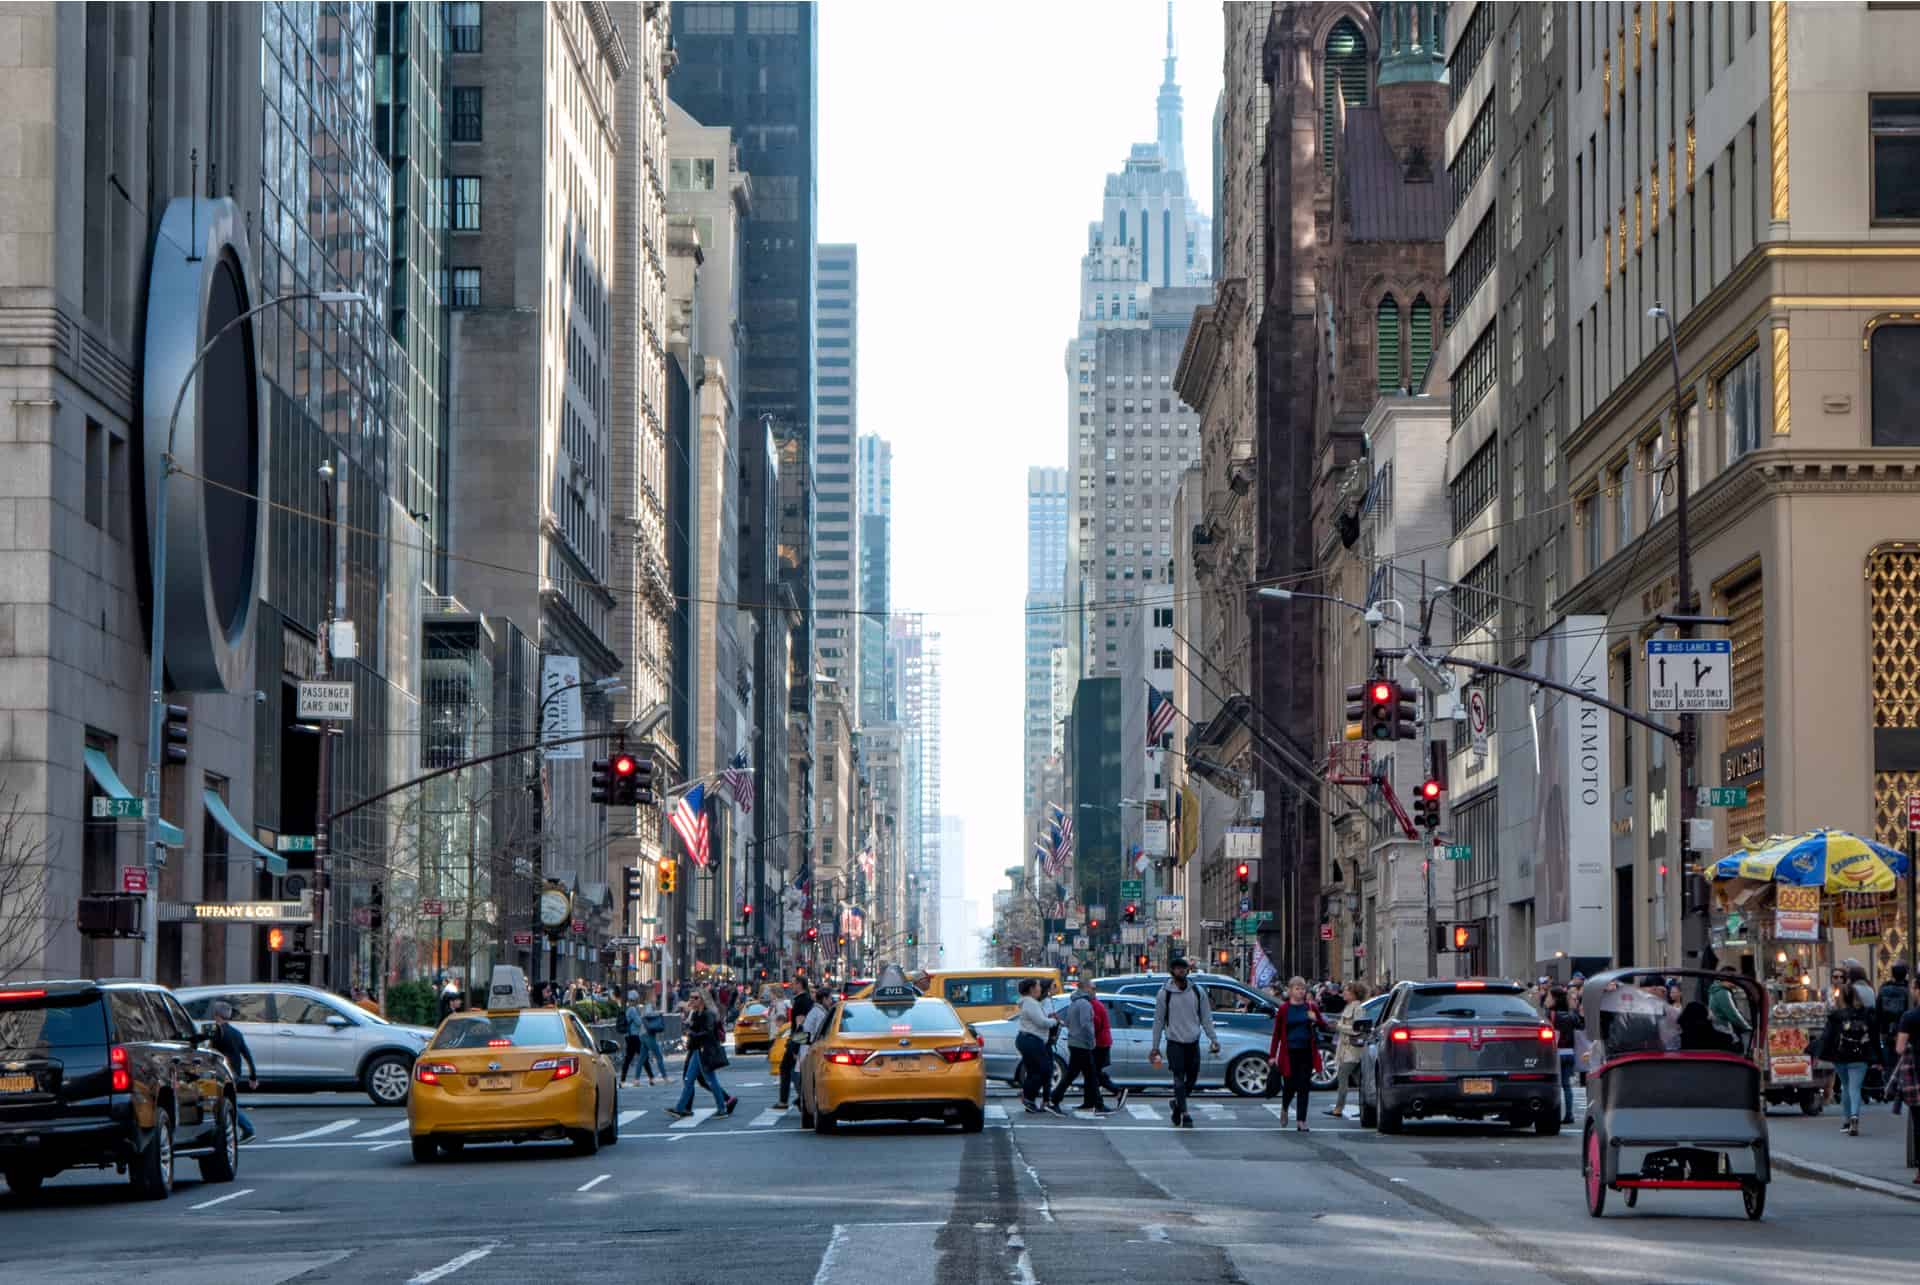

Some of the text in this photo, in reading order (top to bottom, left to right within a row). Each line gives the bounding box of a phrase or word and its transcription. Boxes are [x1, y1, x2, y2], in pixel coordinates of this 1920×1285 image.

[302, 687, 350, 698] PASSENGER
[302, 701, 349, 712] CARS ONLY
[1727, 747, 1762, 781] BVLGARI
[1711, 789, 1721, 804] W
[1724, 789, 1736, 804] 57
[118, 800, 130, 815] 57
[194, 905, 242, 917] TIFFANY
[245, 905, 253, 917] &
